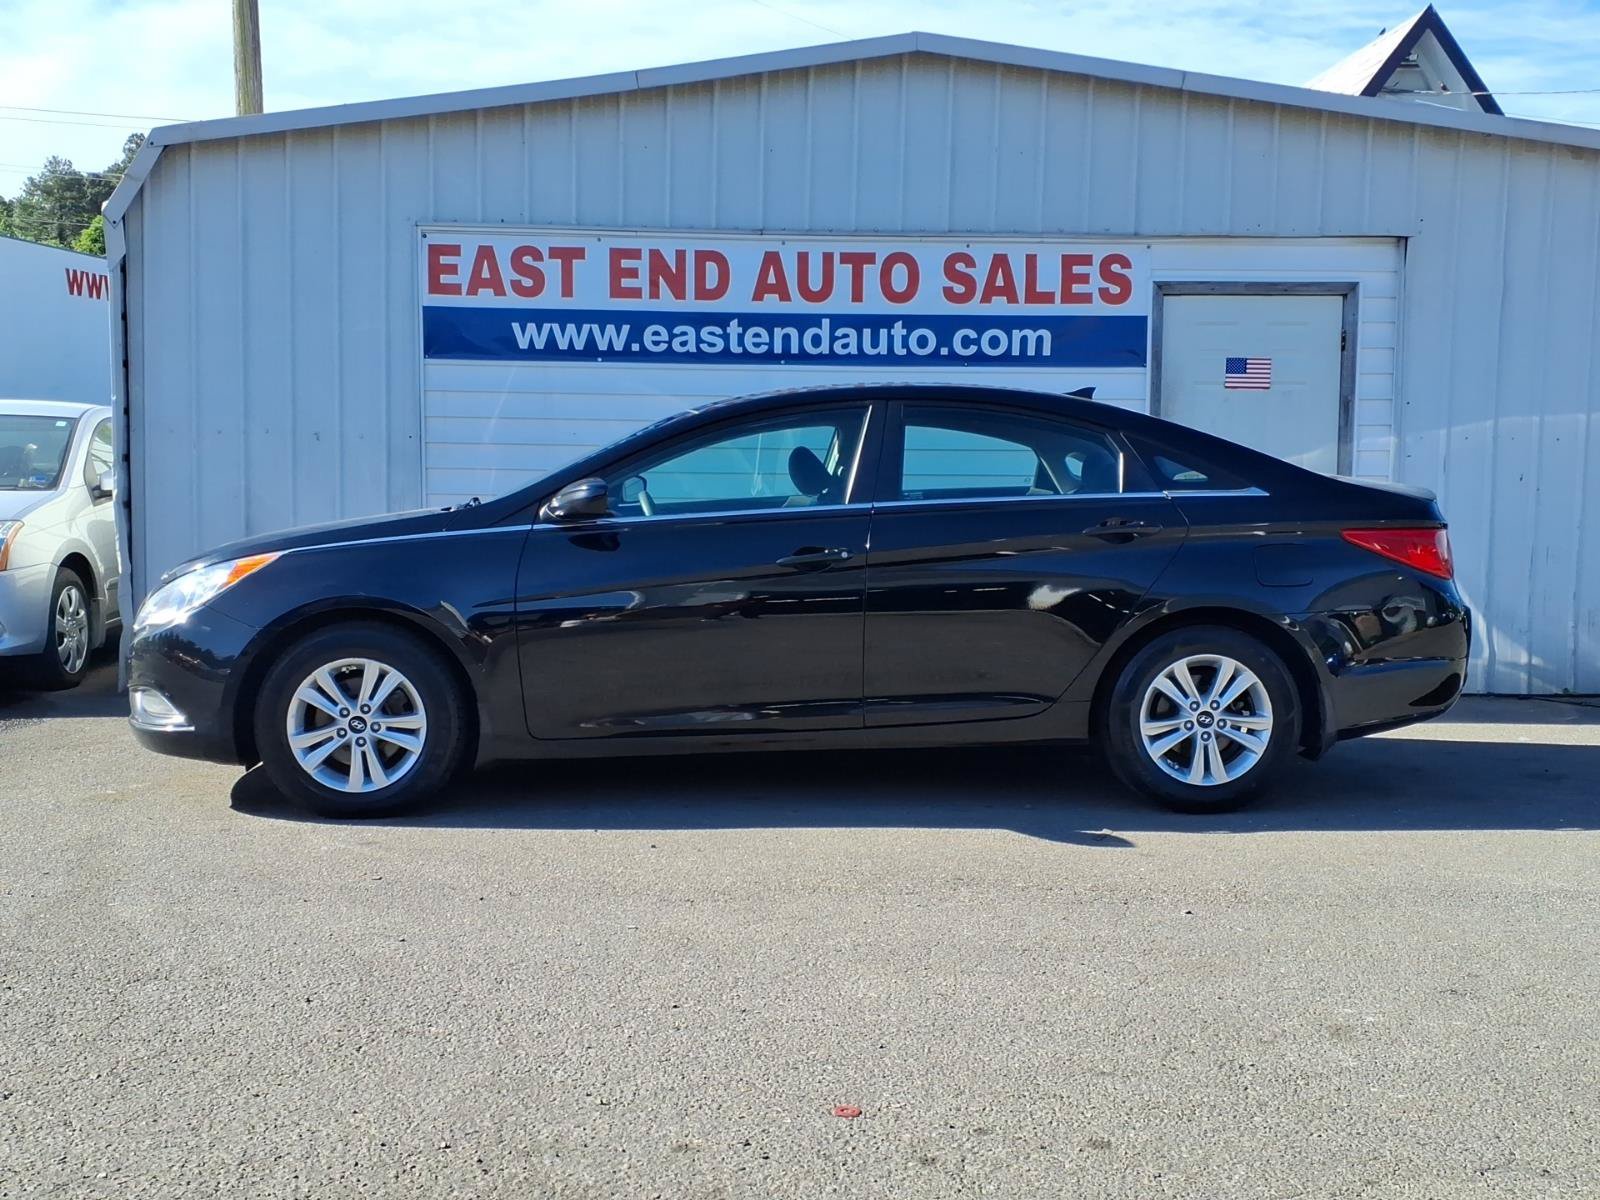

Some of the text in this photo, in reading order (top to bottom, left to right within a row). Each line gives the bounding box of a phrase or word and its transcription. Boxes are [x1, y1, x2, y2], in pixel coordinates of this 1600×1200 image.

[65, 267, 109, 301] WW
[427, 243, 1133, 306] EAST END AUTO SALES
[511, 318, 1053, 357] www.eastendauto.com
